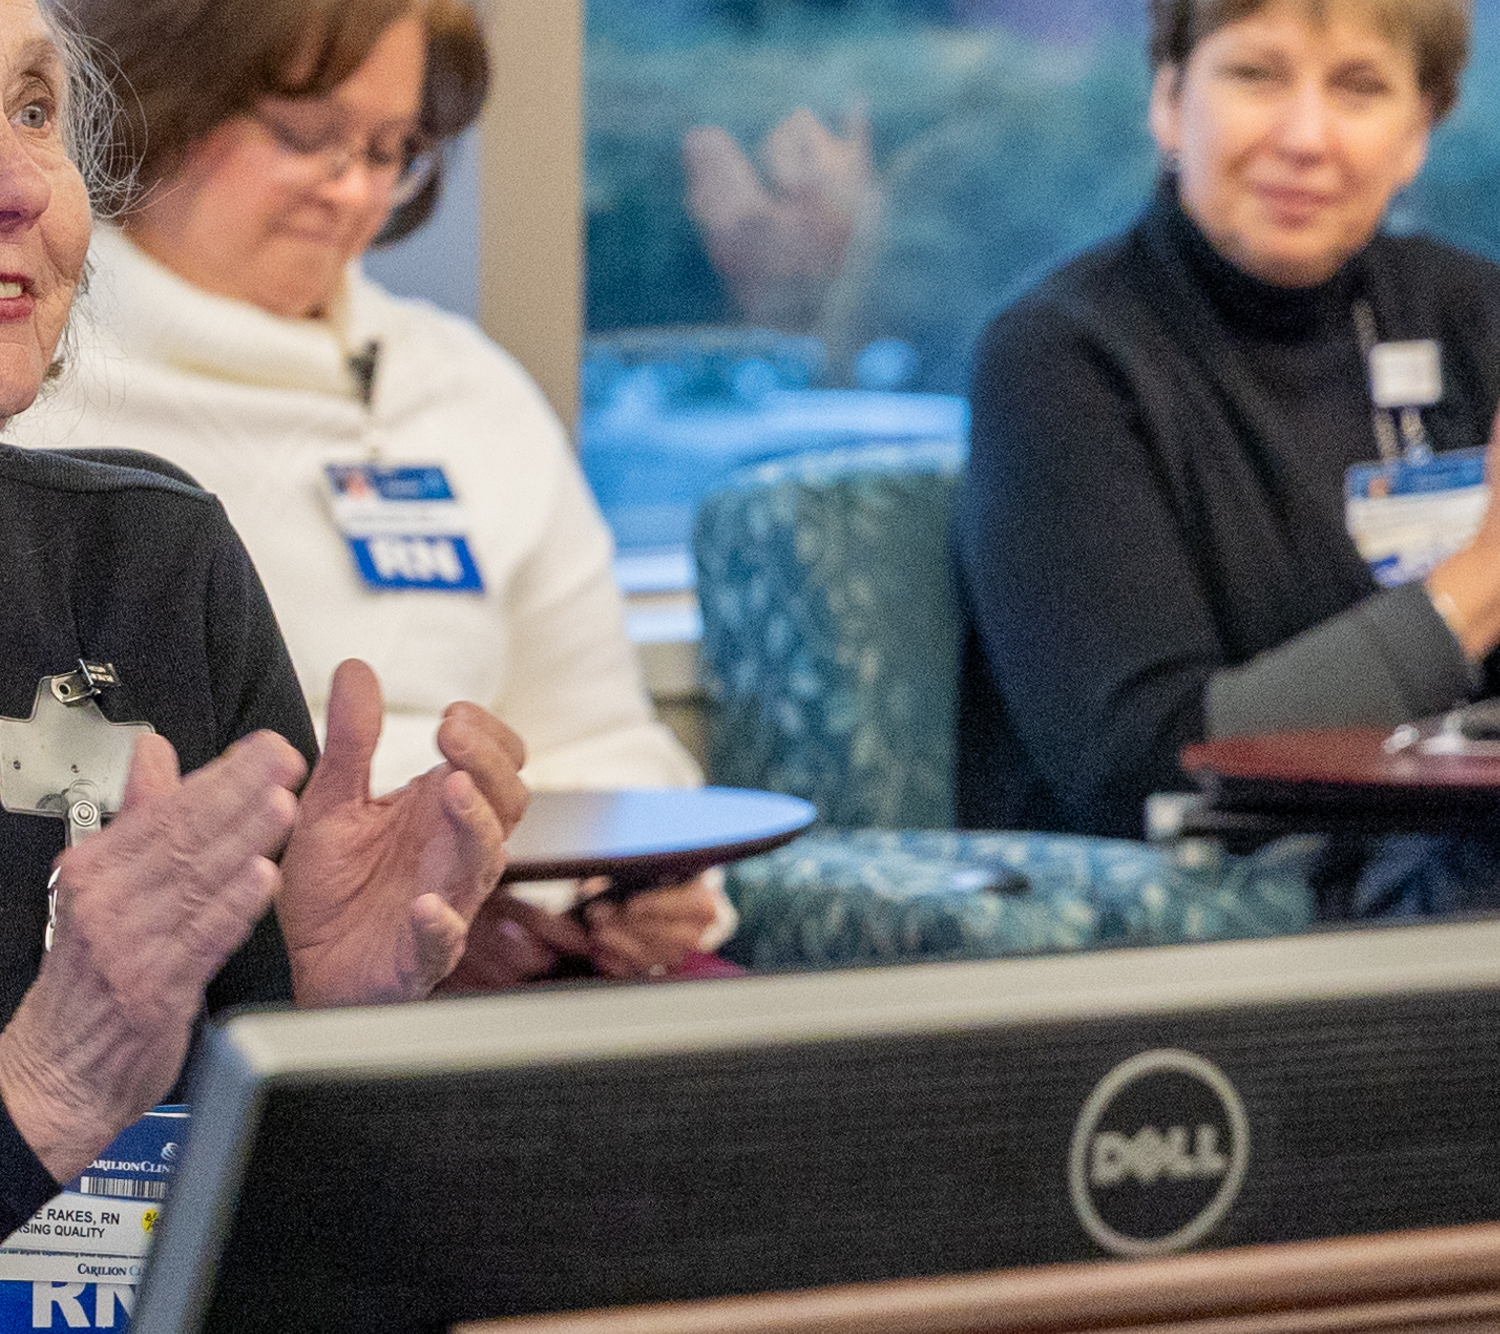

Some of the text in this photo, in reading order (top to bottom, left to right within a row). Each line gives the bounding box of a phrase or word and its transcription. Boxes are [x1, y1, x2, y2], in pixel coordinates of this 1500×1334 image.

[1091, 1124, 1229, 1186] DELL
[86, 1159, 140, 1172] ARILION
[47, 1208, 96, 1226] RAKES,
[101, 1212, 120, 1225] RN
[18, 1222, 105, 1238] SING QUALITY
[77, 1263, 127, 1276] CARILION
